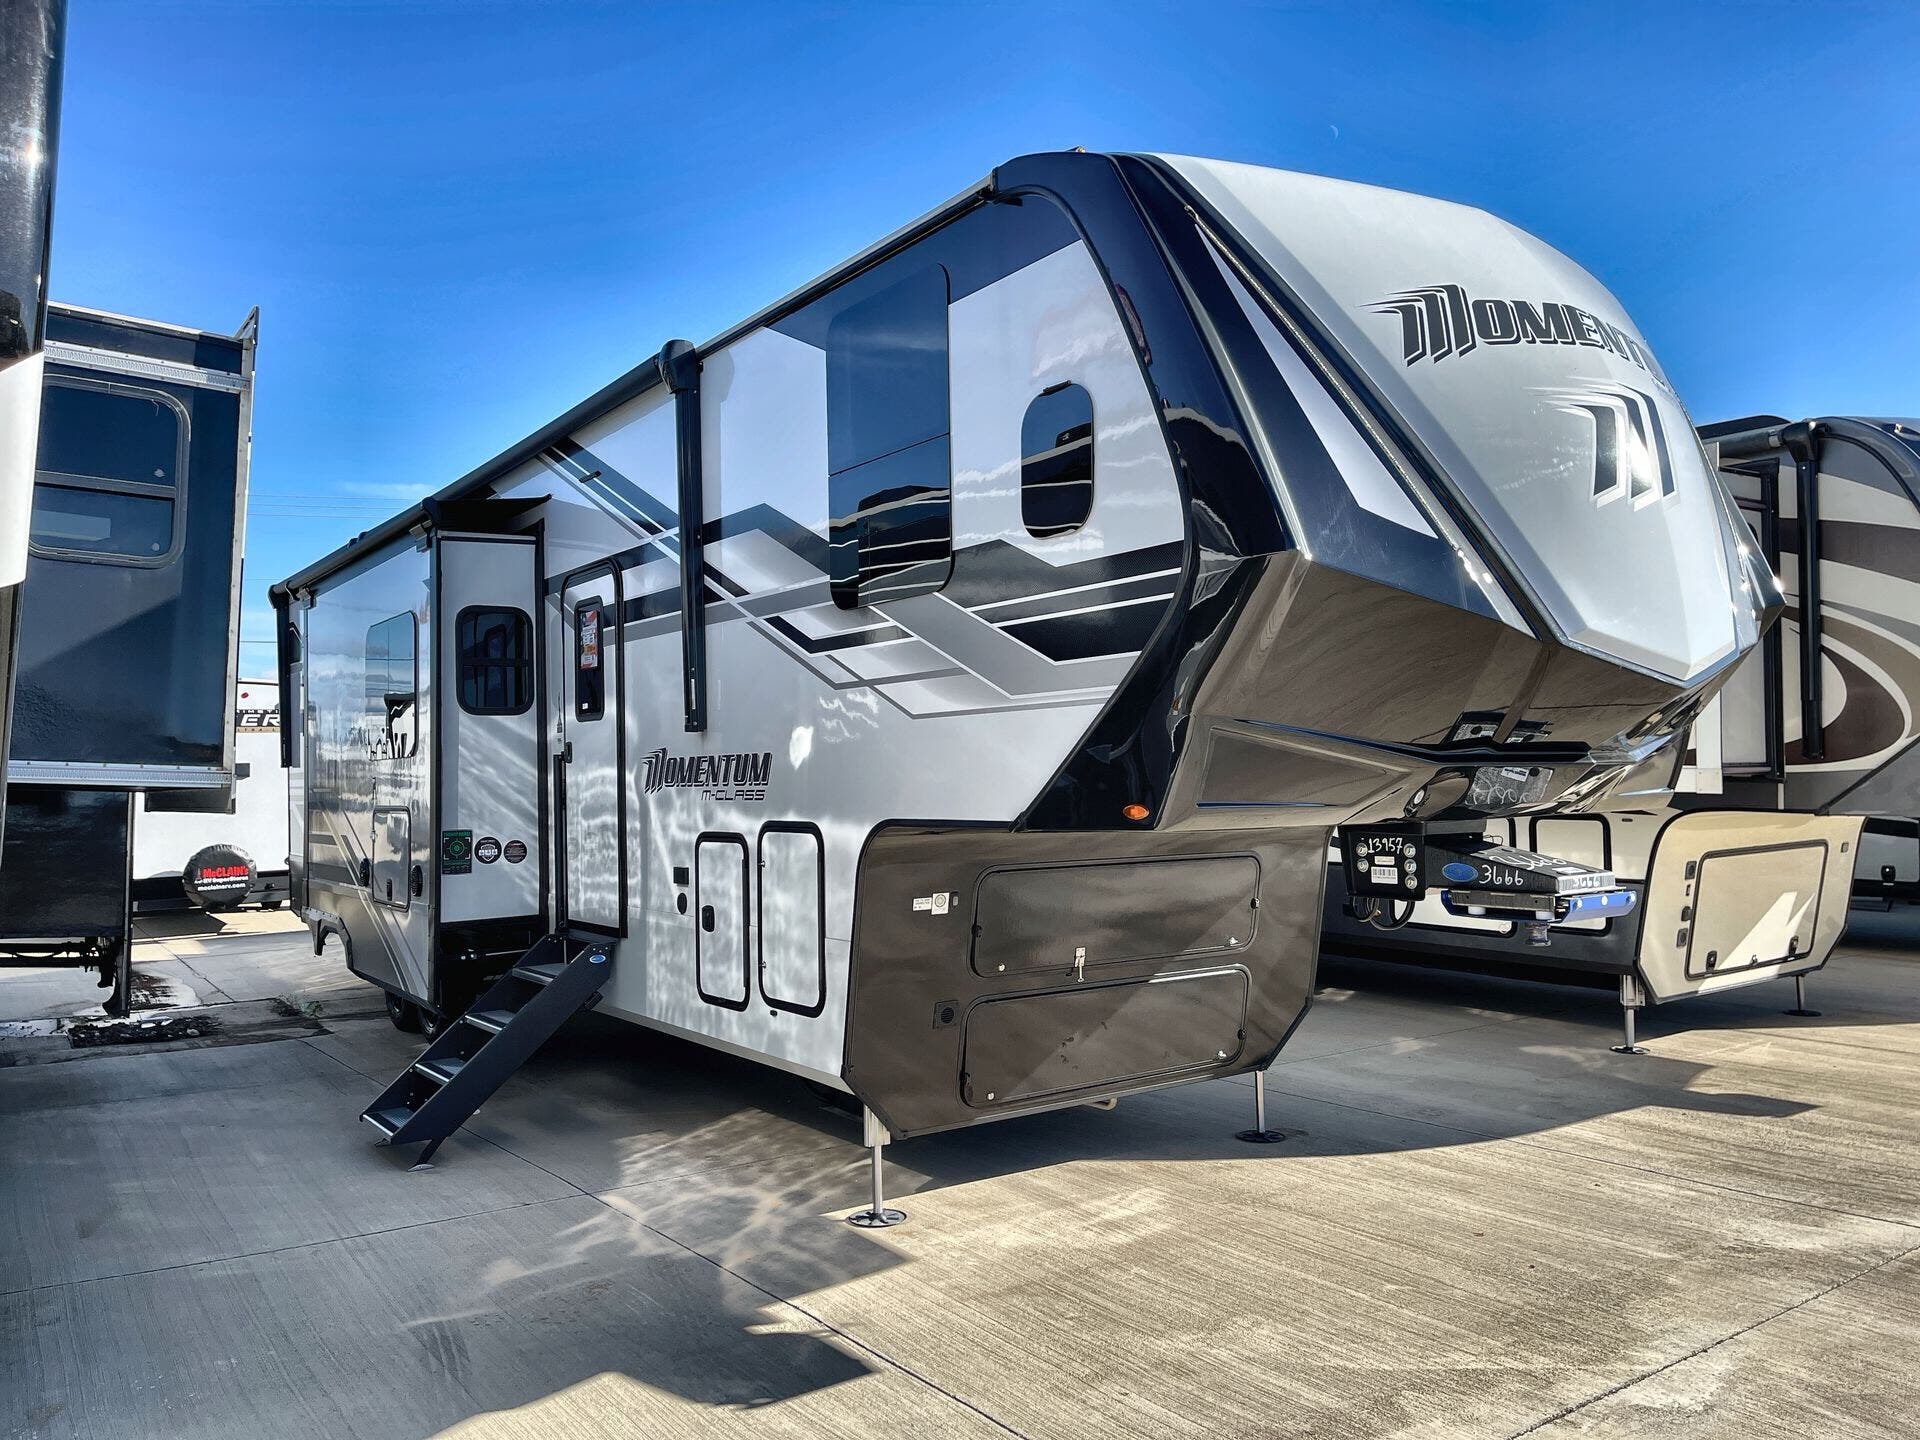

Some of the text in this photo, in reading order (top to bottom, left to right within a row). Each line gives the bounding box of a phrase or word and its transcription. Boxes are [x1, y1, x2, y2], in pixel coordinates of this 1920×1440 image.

[1357, 284, 1667, 388] MOMENT
[641, 747, 772, 794] MOMENTUM
[1367, 837, 1403, 855] 13957
[1478, 864, 1525, 886] 3666
